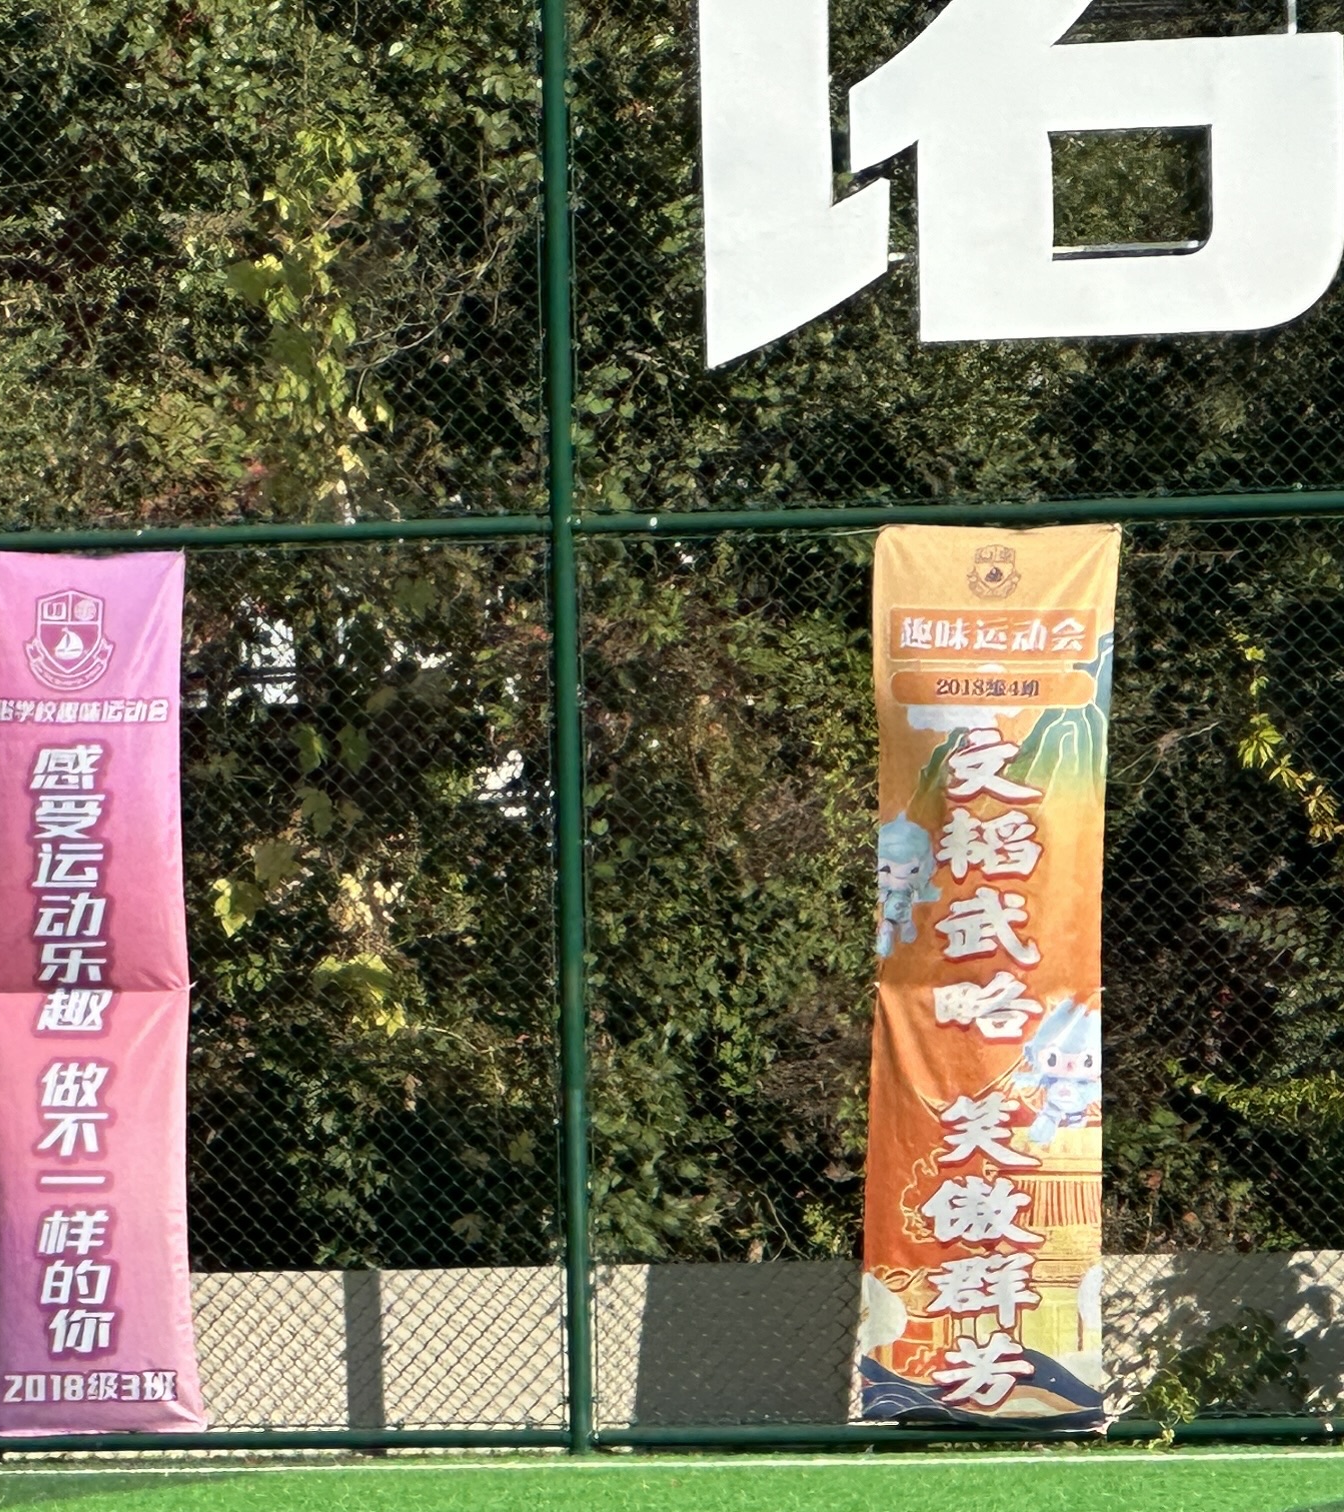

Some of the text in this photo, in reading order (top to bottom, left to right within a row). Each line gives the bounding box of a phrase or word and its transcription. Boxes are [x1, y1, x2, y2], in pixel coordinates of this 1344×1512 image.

[899, 616, 1087, 651] 趣味运动会
[29, 744, 113, 1032] 感受运动乐趣
[36, 1061, 116, 1354] 做不一样的你
[921, 727, 1046, 1407] 文韬武略 笑傲群芳
[4, 1371, 177, 1402] 2018级3班
